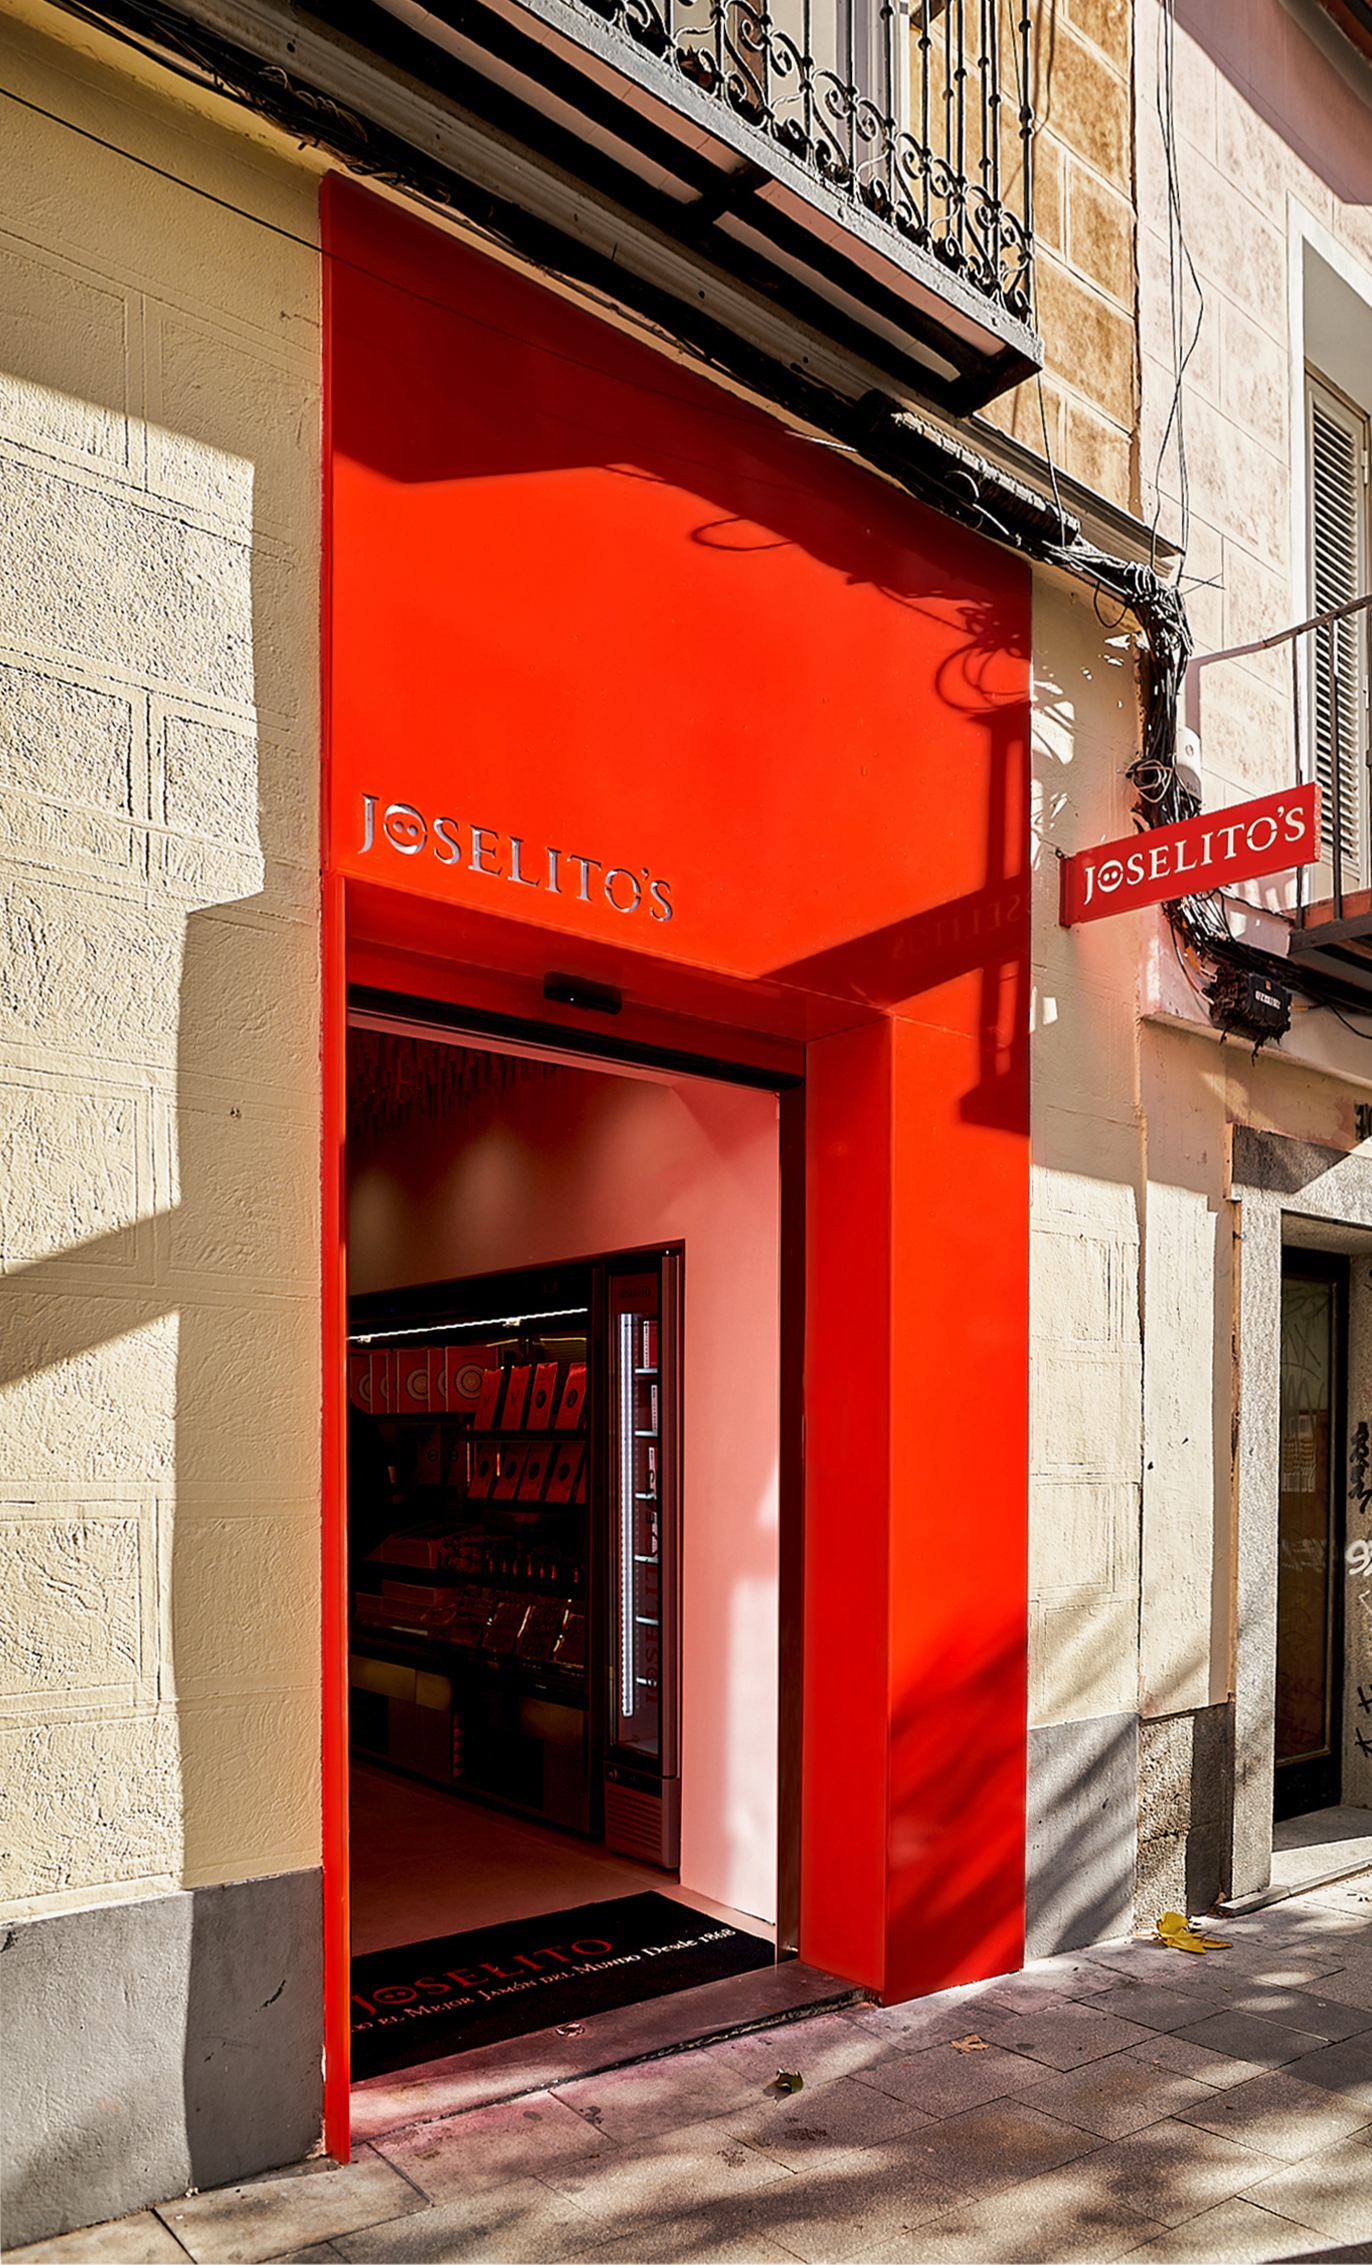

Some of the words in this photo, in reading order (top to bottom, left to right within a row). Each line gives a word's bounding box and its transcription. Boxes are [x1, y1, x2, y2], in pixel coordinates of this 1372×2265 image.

[358, 793, 673, 921] JOSELITO'S
[1084, 805, 1306, 905] JOSELITO'S
[351, 1939, 612, 2017] JOSELITO
[698, 1927, 736, 1944] 1868
